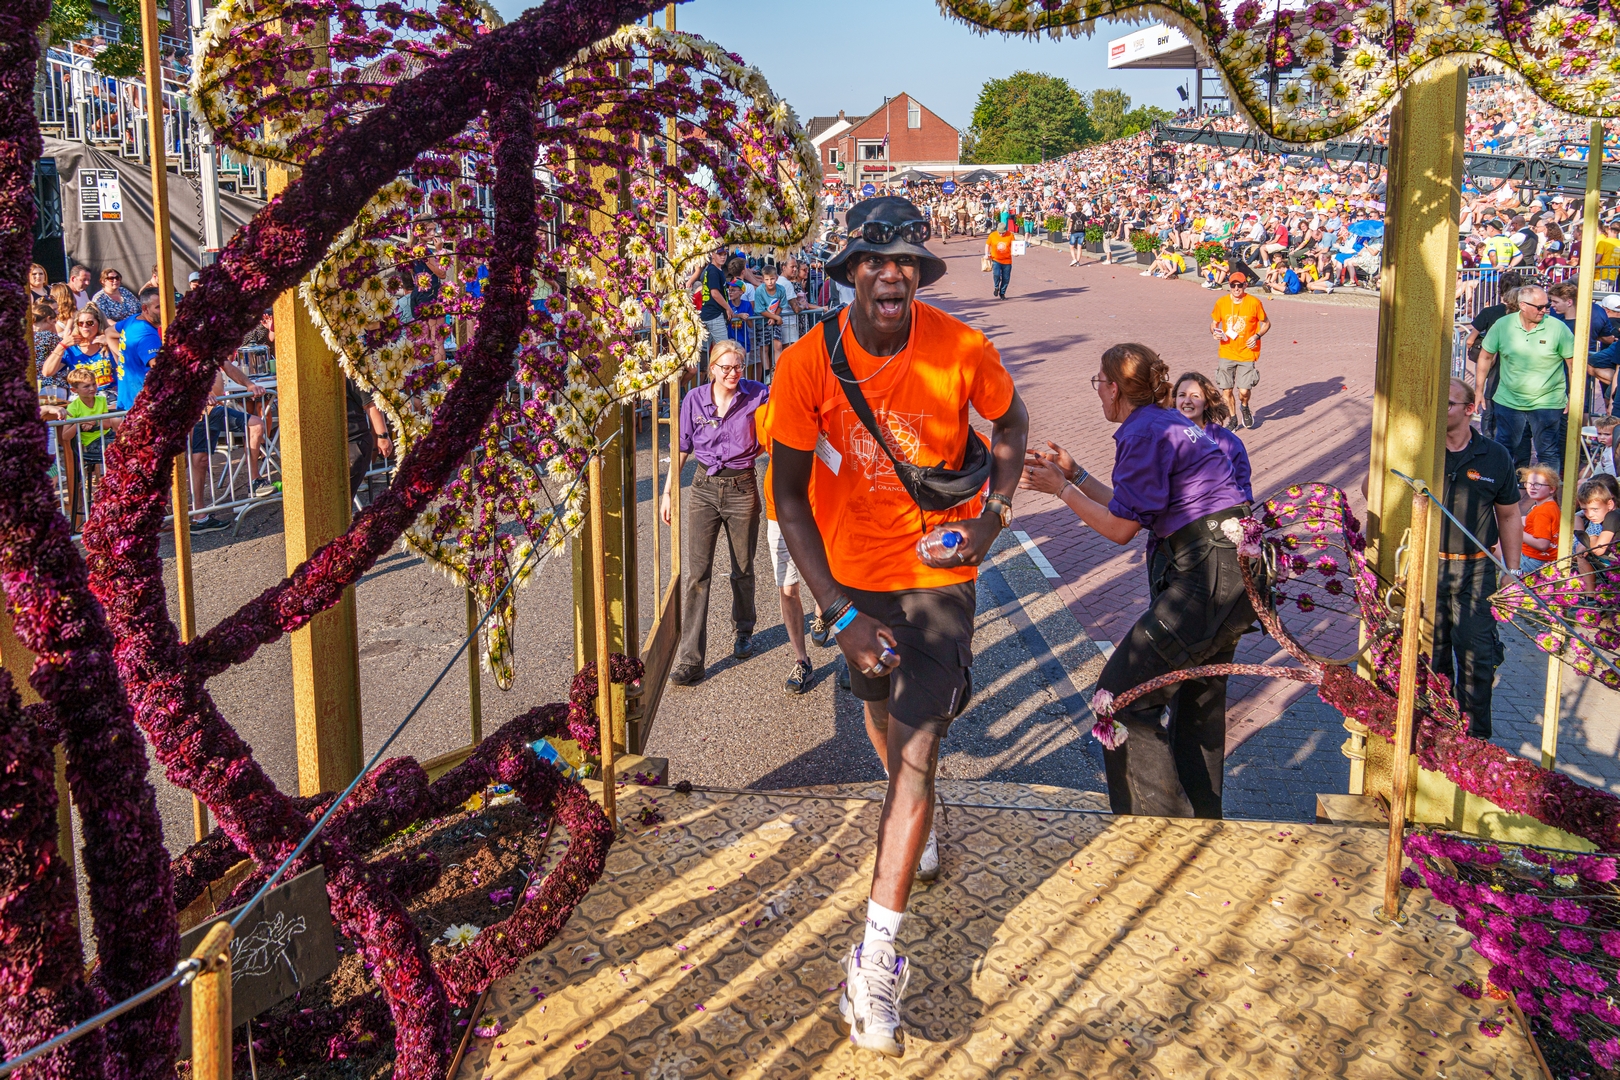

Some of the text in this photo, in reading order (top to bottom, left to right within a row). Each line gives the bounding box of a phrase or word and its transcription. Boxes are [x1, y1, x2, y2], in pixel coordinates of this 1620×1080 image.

[1157, 35, 1169, 46] BHV
[86, 176, 93, 185] B
[866, 916, 891, 936] FILA
